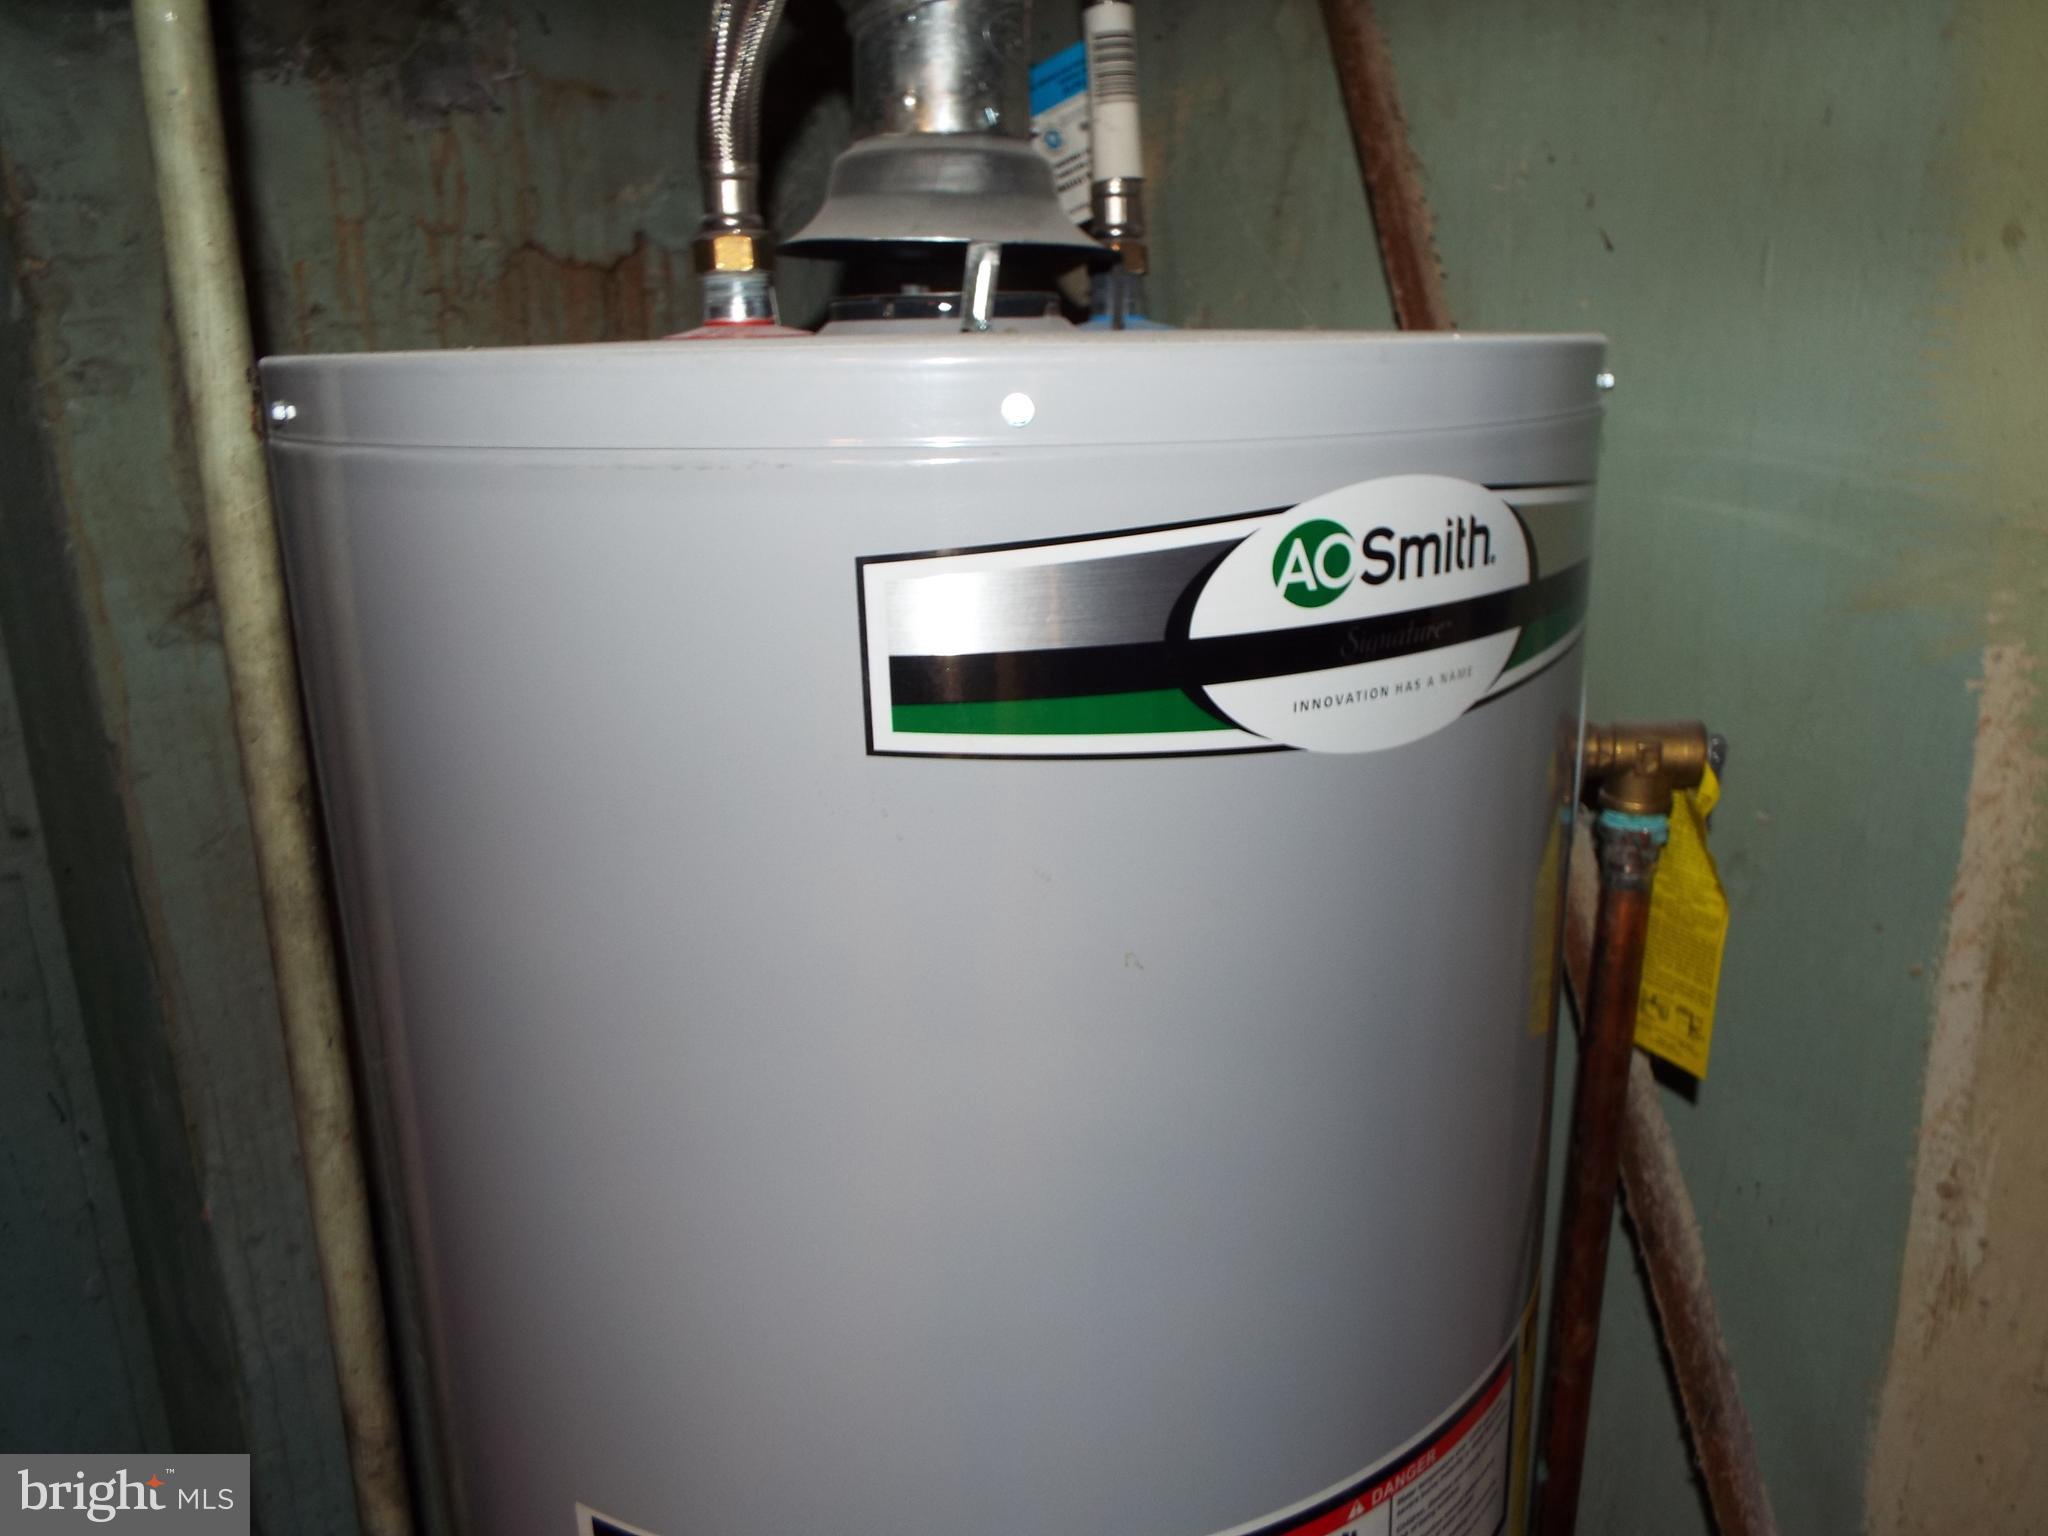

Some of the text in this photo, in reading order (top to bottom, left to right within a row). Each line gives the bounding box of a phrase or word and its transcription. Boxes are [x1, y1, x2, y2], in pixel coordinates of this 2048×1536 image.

[1361, 514, 1490, 585] Smith
[1293, 665, 1473, 713] INNOVATION HAS A NAME
[1371, 1448, 1437, 1506] DANGER
